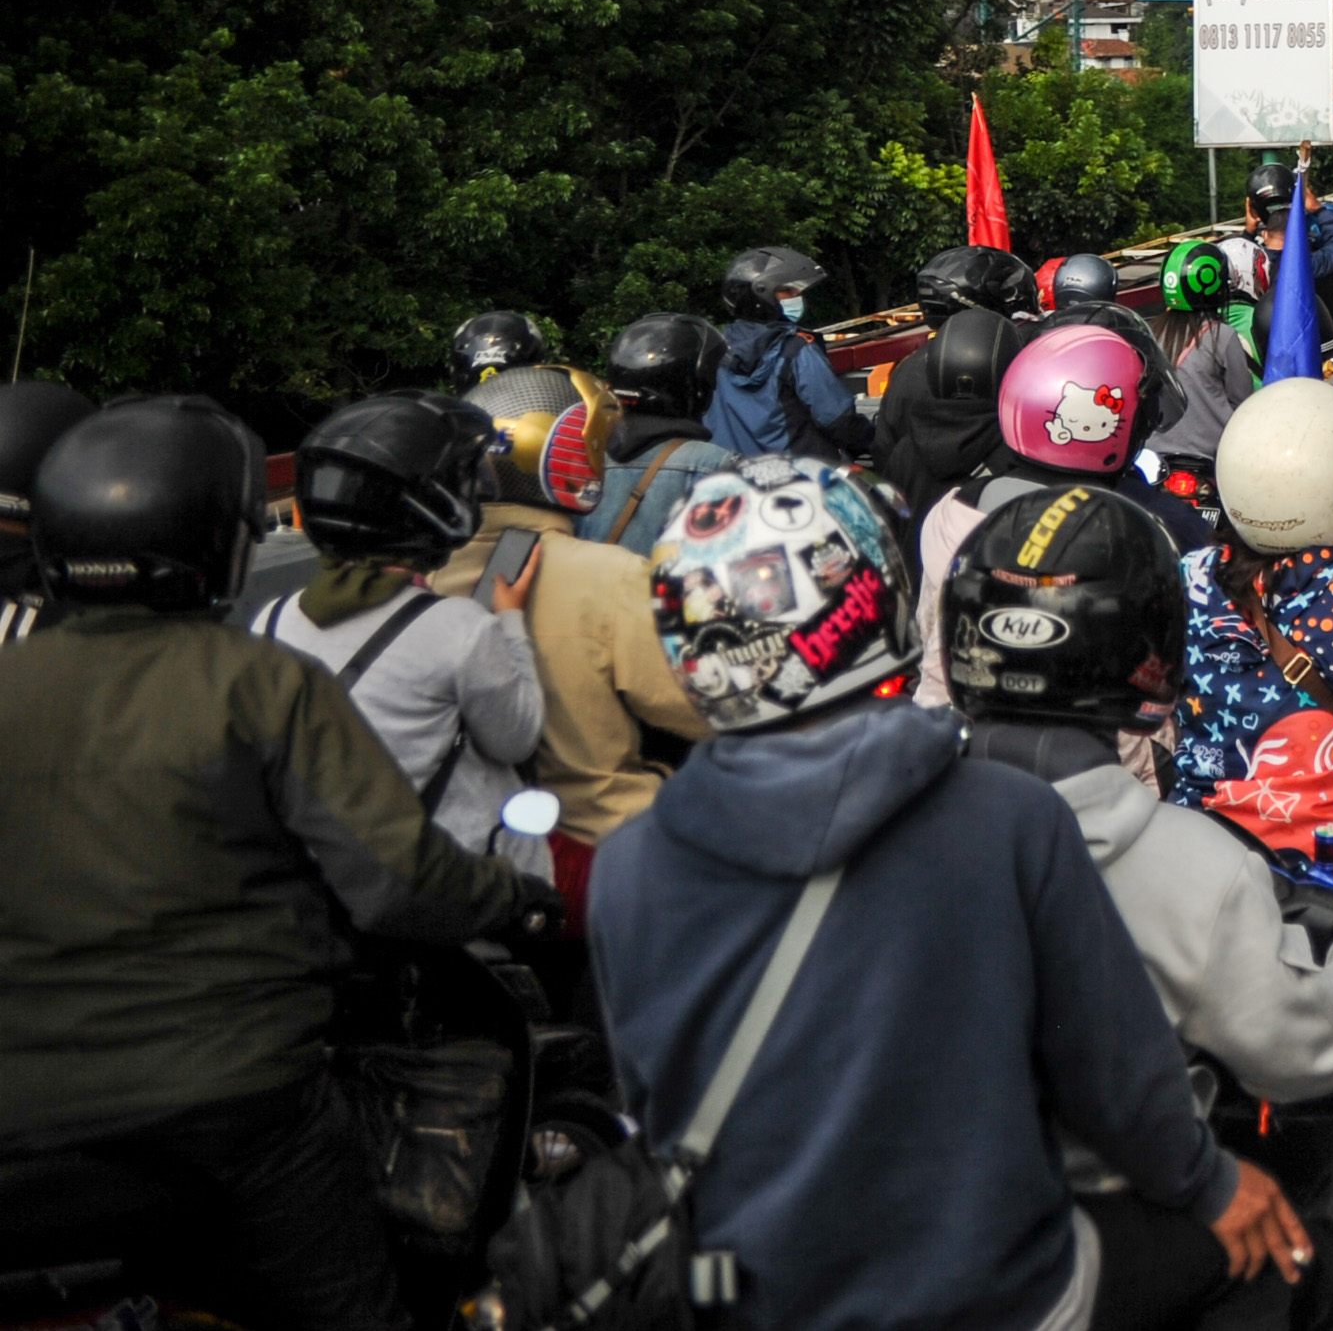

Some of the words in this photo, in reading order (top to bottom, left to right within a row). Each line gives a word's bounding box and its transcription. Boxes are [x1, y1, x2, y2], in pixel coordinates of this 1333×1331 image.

[1199, 23, 1239, 50] 0813
[1244, 23, 1283, 49] 1117
[1286, 22, 1326, 48] 8055
[1016, 486, 1090, 569] SCOTT
[1006, 677, 1040, 690] DOT
